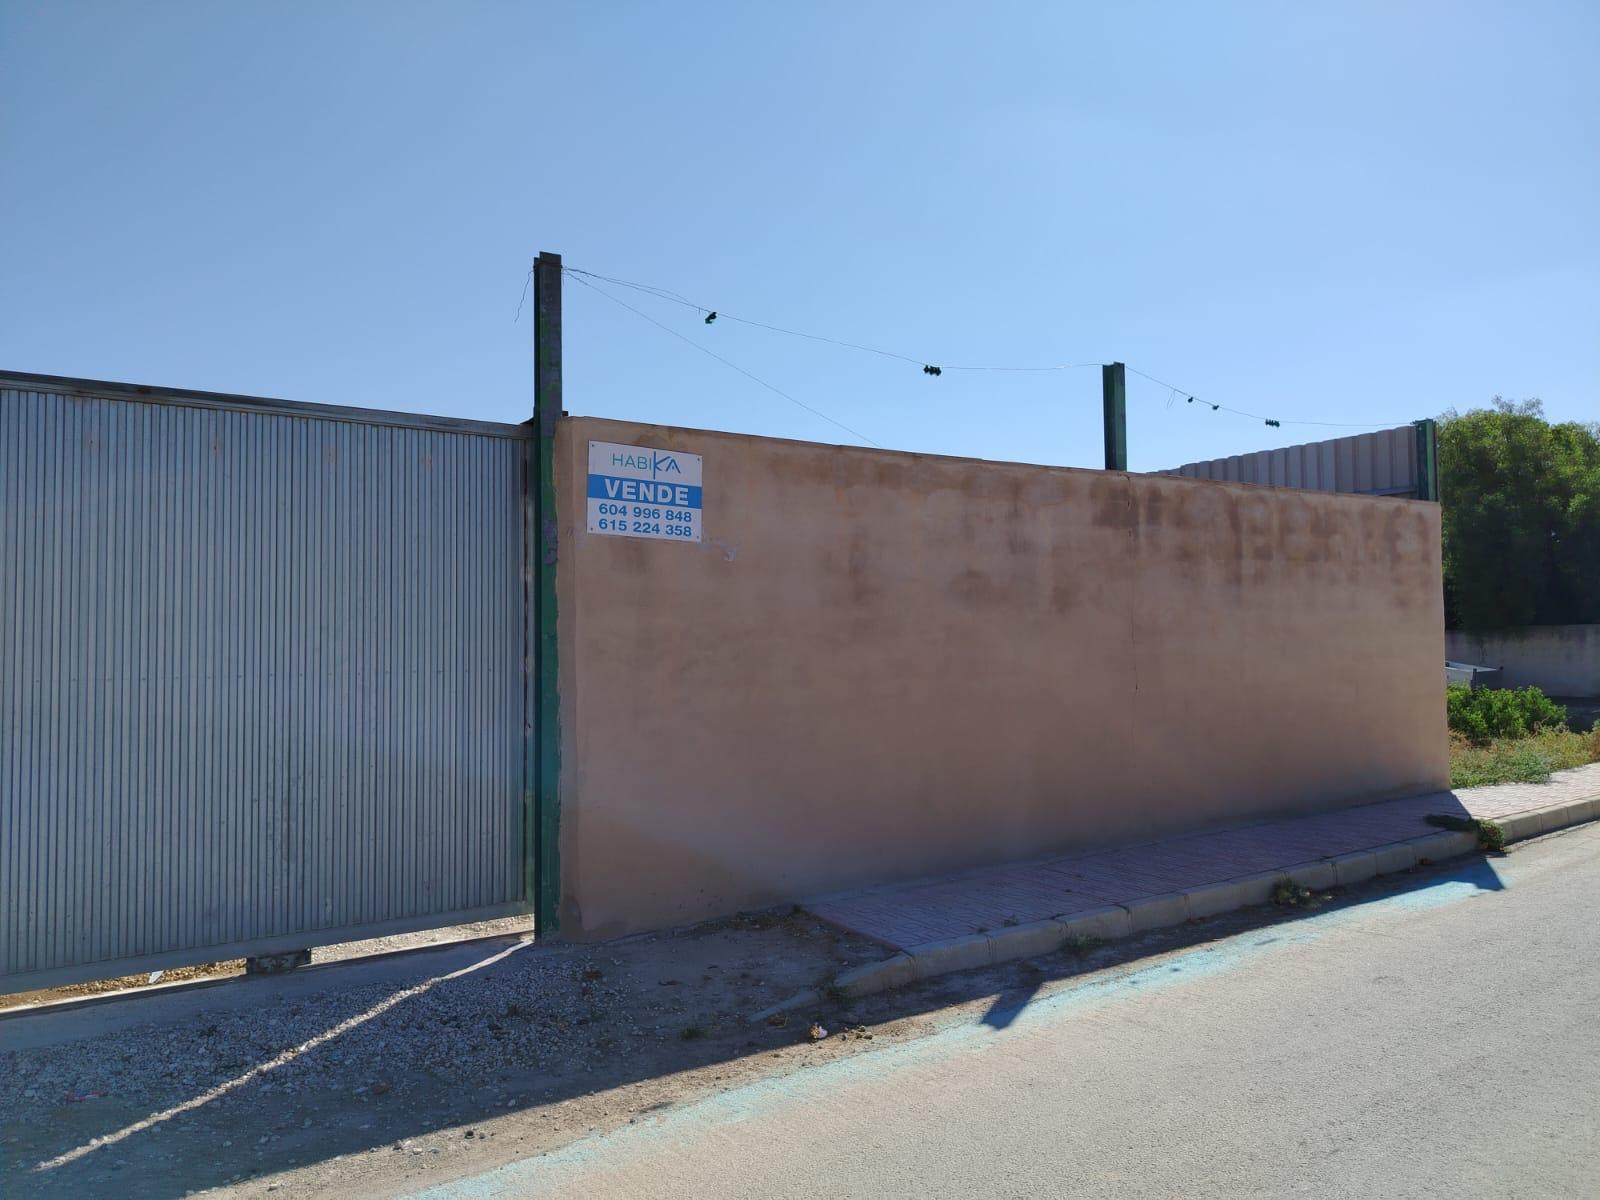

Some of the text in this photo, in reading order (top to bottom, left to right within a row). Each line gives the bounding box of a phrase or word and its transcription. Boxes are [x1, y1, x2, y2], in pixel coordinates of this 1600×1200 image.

[612, 451, 681, 480] HABIKA
[604, 478, 689, 506] VENDE
[598, 503, 692, 523] 604 996 848
[598, 518, 692, 537] 615 224 358
